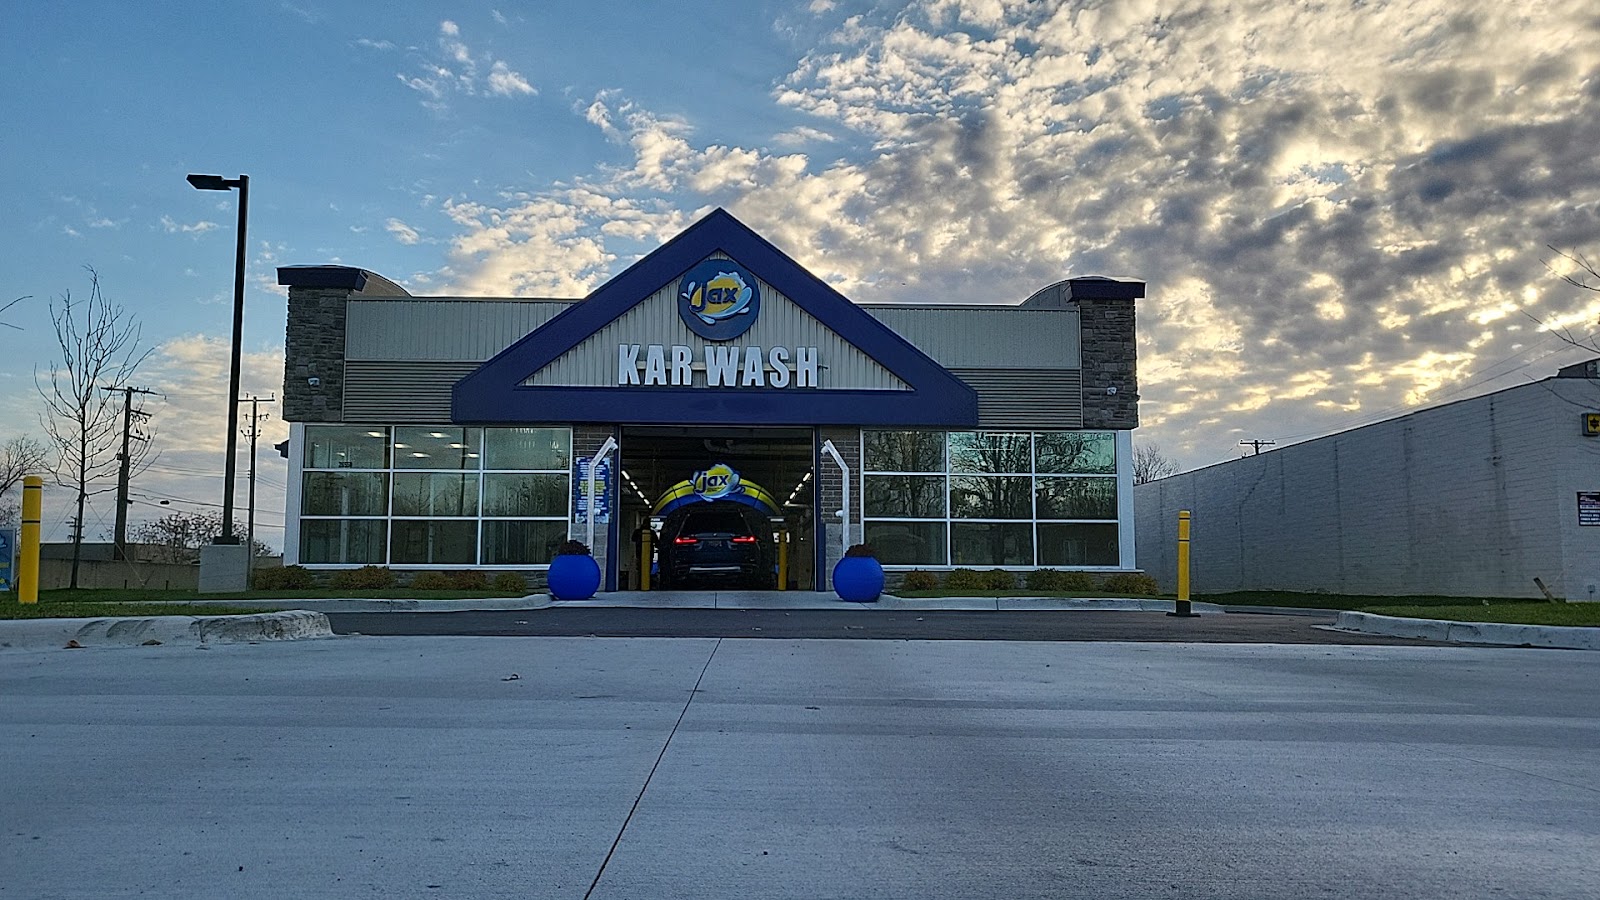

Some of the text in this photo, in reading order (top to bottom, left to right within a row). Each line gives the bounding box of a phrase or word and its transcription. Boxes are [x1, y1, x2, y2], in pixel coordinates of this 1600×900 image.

[618, 344, 818, 389] KAR WASH
[695, 472, 729, 493] jax
